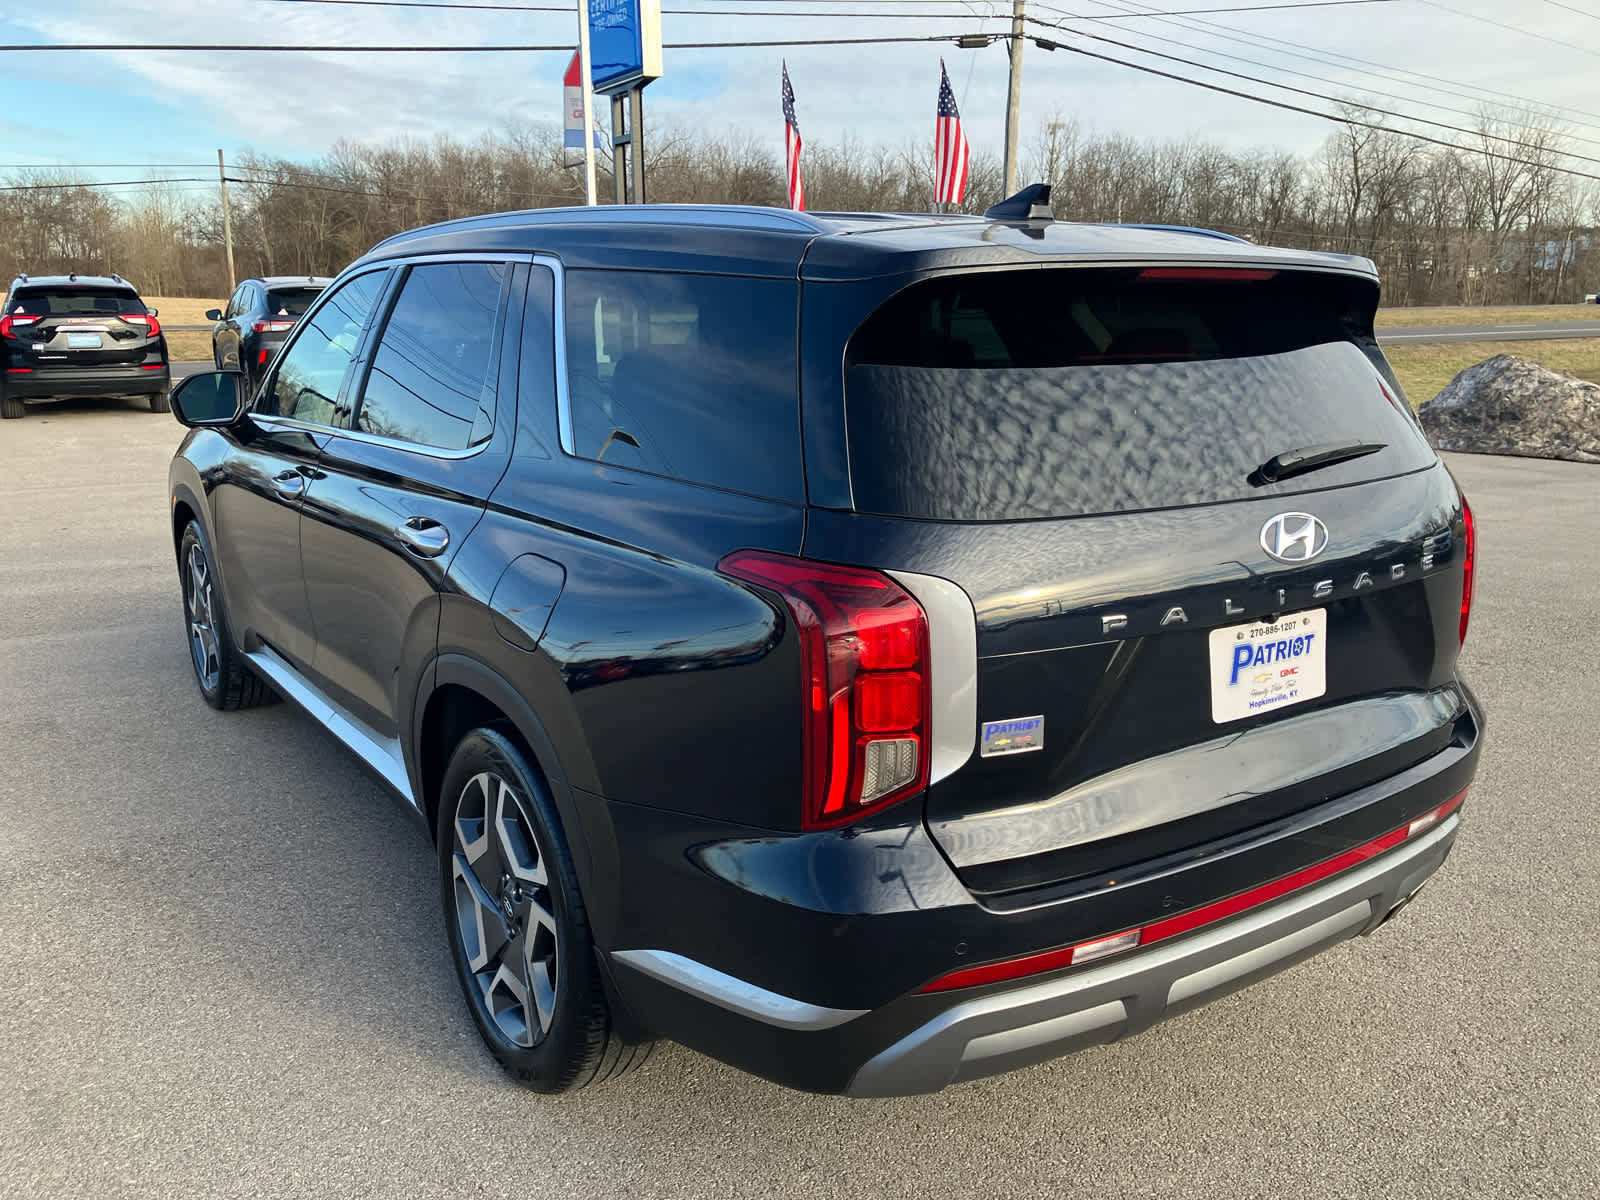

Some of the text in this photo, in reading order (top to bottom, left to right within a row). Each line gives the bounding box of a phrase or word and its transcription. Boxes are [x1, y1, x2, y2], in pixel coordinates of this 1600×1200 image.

[1101, 553, 1434, 633] PALISADE
[1229, 634, 1314, 685] PATRIOT
[1280, 667, 1299, 677] GMC
[1289, 689, 1298, 697] KY
